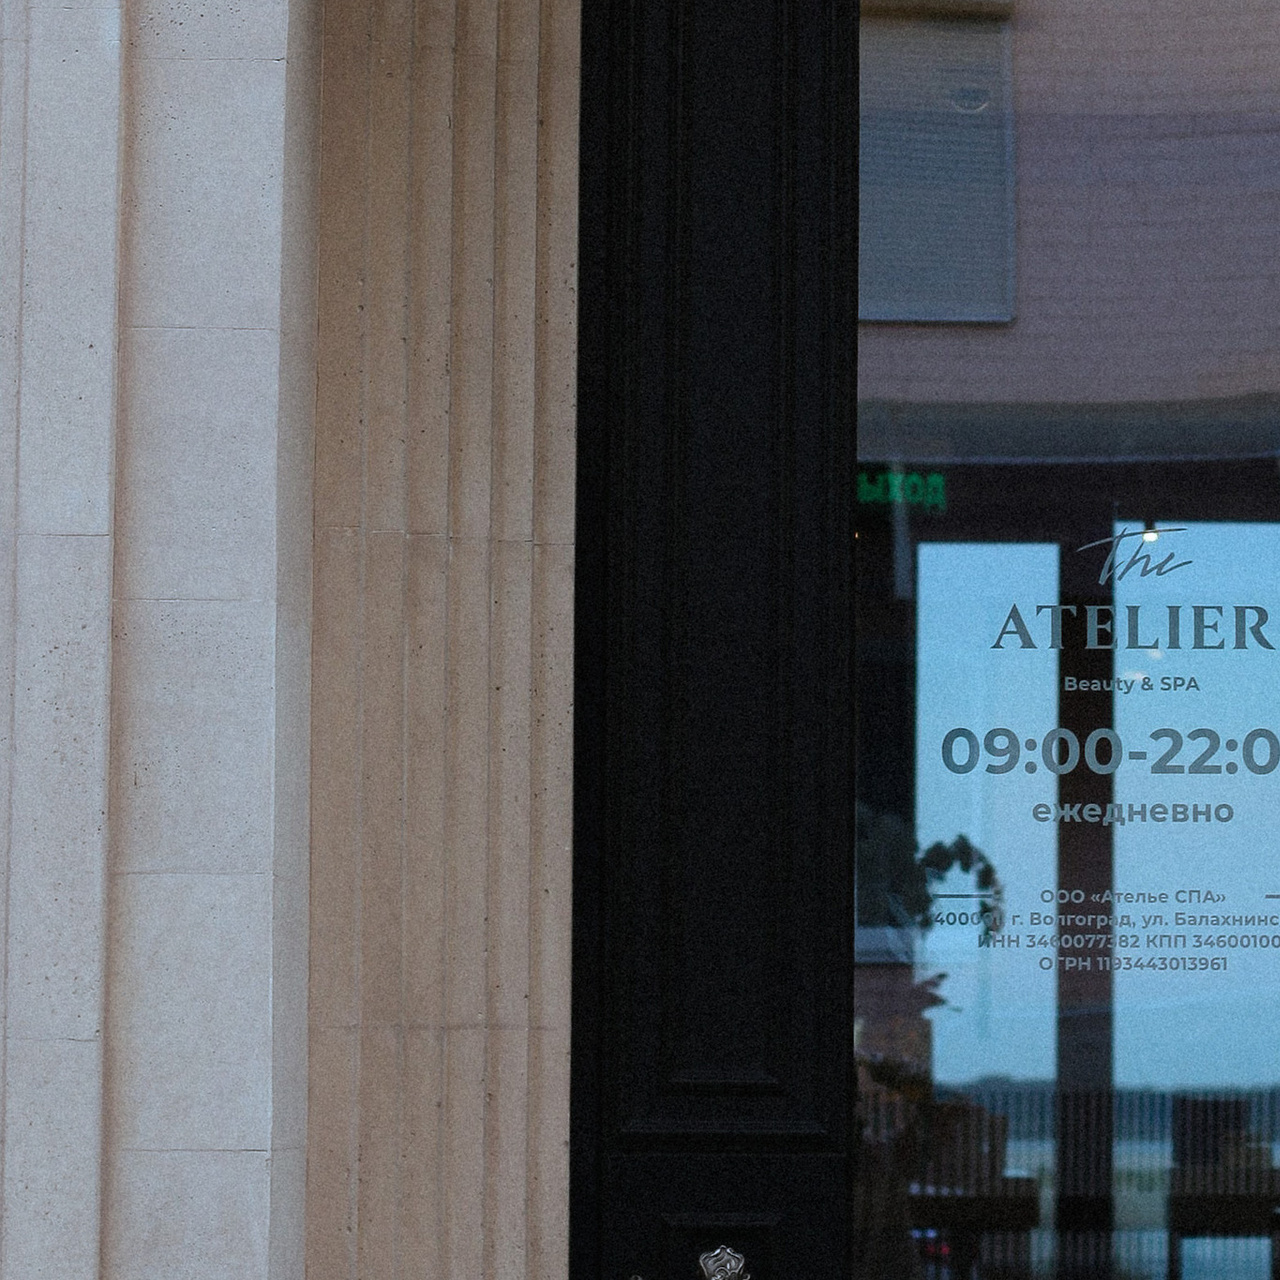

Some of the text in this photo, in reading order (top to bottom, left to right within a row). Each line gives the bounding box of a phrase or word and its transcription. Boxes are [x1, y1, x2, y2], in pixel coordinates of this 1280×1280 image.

[857, 471, 947, 513] ЫХОД
[990, 603, 1276, 651] ATELIER
[1064, 676, 1200, 695] Beauty & SPA
[1032, 802, 1234, 826] ежедневно
[1040, 888, 1226, 904] ООО «Ателье СПА»
[1012, 914, 1024, 926] г.
[1030, 911, 1136, 929] Волгоград,
[1142, 914, 1169, 929] ул.
[978, 934, 1021, 949] ИНН
[1026, 934, 1140, 949] 3460077382
[1146, 934, 1187, 949] КПП
[1039, 957, 1228, 972] ОГРН 1193443013961
